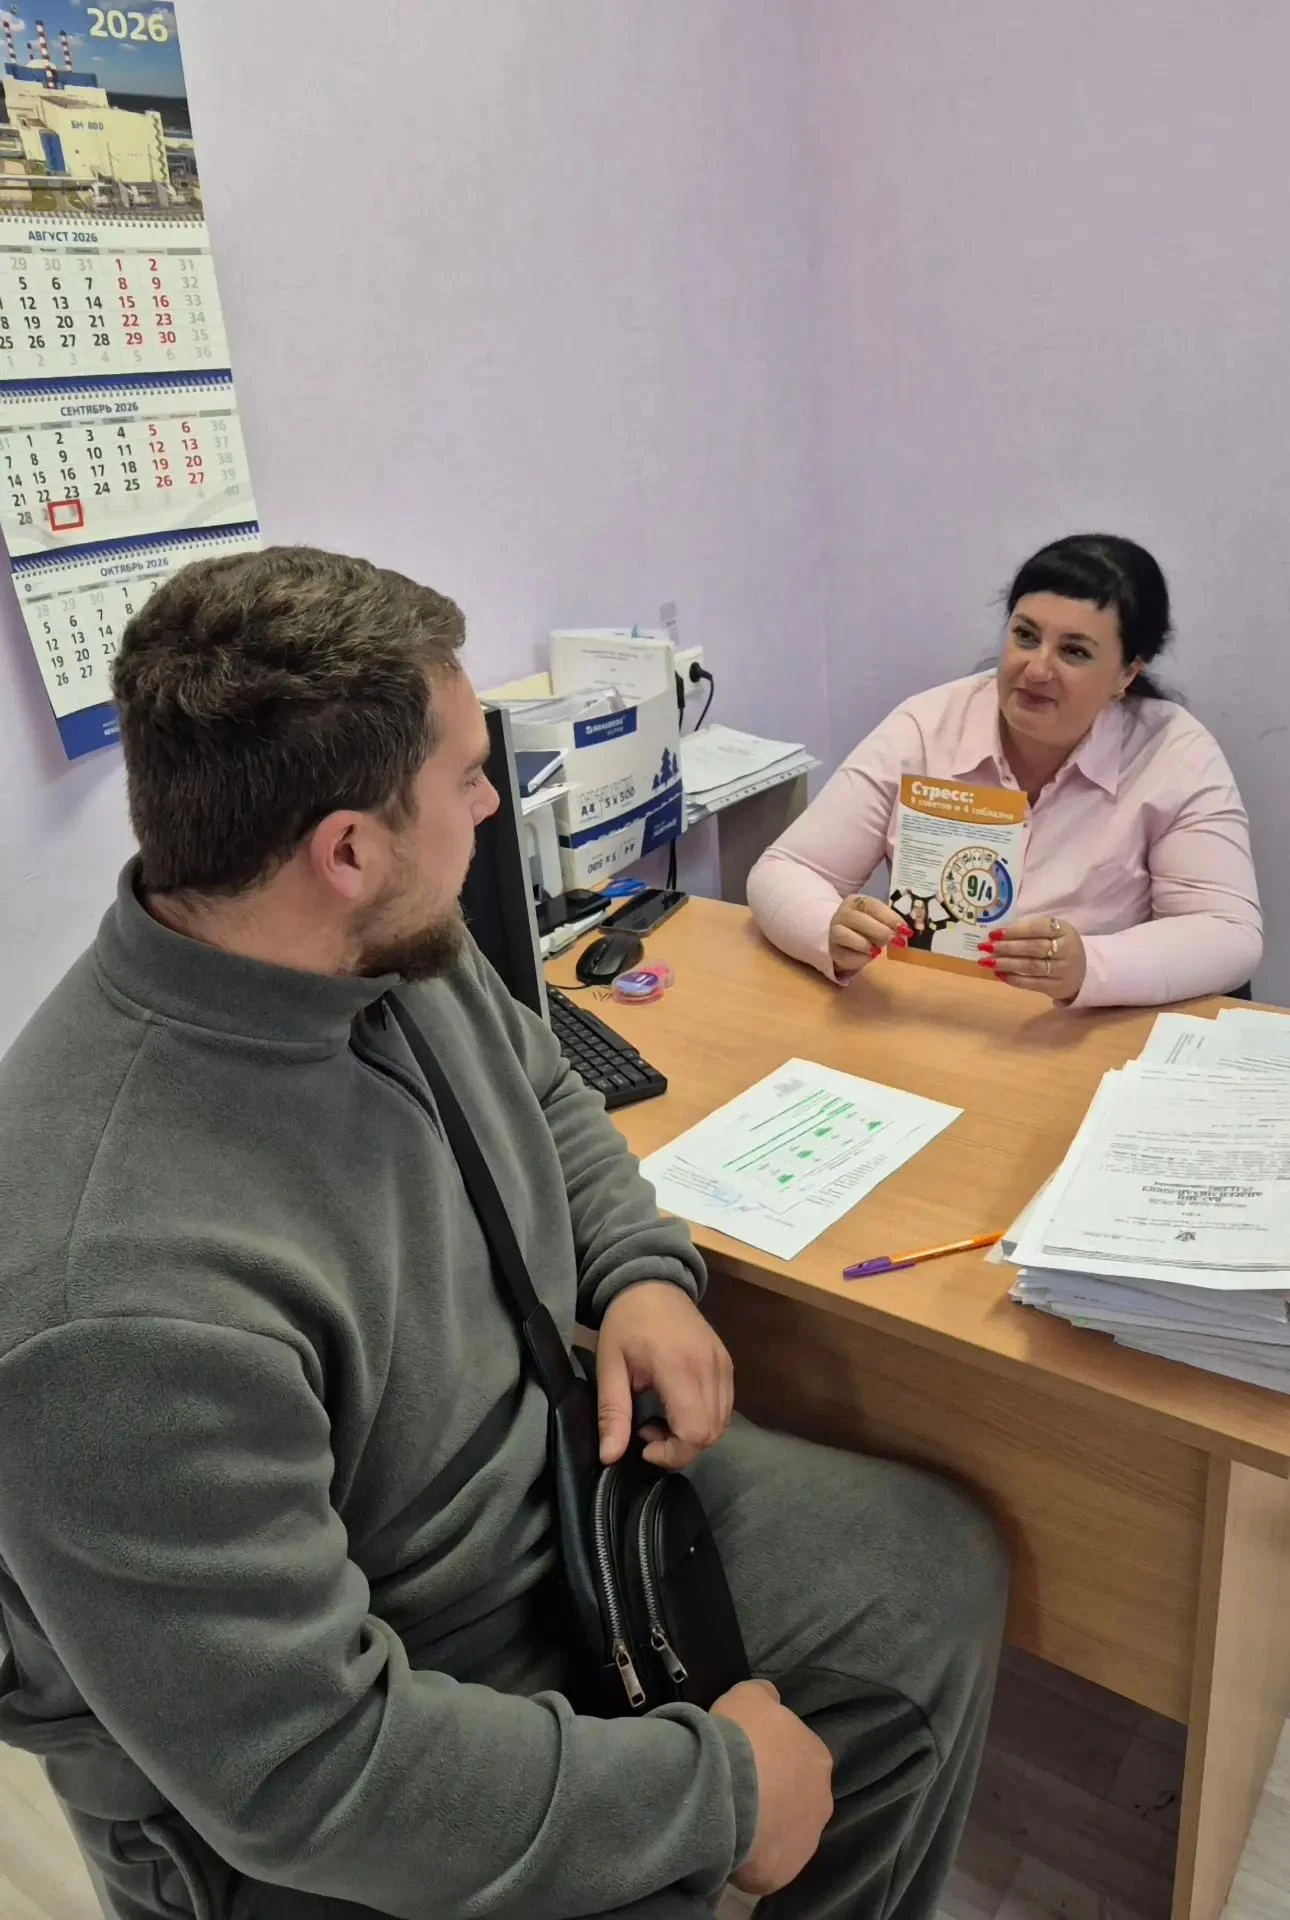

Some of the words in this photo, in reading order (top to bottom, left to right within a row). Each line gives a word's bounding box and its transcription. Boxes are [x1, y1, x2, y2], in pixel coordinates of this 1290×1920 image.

[86, 7, 169, 42] 2026
[28, 230, 69, 242] АВГУСТ
[71, 232, 98, 243] 2026
[10, 257, 27, 271] 29
[43, 258, 61, 271] 30
[76, 258, 94, 271] 31
[115, 259, 123, 271] 1
[149, 259, 158, 271] 2
[18, 277, 27, 290] 5
[51, 277, 61, 290] 6
[84, 277, 93, 290] 7
[118, 277, 128, 290] 8
[152, 277, 161, 290] 9
[19, 296, 37, 310] 12
[52, 296, 69, 310] 13
[86, 296, 103, 310] 14
[119, 296, 135, 309] 15
[152, 295, 169, 308] 16
[0, 316, 10, 330] 8
[24, 316, 41, 329] 19
[56, 316, 74, 329] 20
[88, 315, 105, 328] 21
[121, 314, 140, 327] 22
[155, 313, 173, 326] 23
[28, 335, 45, 349] 26
[60, 334, 76, 348] 27
[93, 334, 110, 346] 28
[125, 332, 143, 345] 29
[159, 331, 176, 344] 30
[60, 403, 112, 417] СЕНТЯБРЬ
[115, 402, 139, 414] 2026
[27, 435, 34, 448] 1
[55, 432, 64, 445] 2
[86, 429, 94, 442] 3
[117, 426, 126, 439] 4
[148, 424, 158, 437] 5
[182, 422, 191, 434] 6
[5, 456, 13, 469] 7
[30, 453, 39, 466] 8
[59, 450, 68, 464] 9
[86, 447, 103, 460] 10
[117, 444, 132, 457] 11
[149, 442, 165, 454] 12
[182, 439, 198, 451] 13
[8, 474, 23, 488] 14
[32, 471, 47, 485] 15
[60, 468, 76, 481] 16
[90, 464, 105, 477] 17
[121, 461, 137, 474] 18
[152, 458, 169, 471] 19
[184, 455, 203, 468] 20
[12, 494, 27, 508] 21
[36, 490, 52, 503] 22
[63, 486, 80, 499] 23
[94, 482, 111, 496] 24
[124, 479, 141, 492] 25
[155, 475, 173, 488] 26
[188, 472, 205, 485] 27
[17, 512, 33, 526] 28
[99, 561, 144, 578] ОКТЯБРЬ
[146, 557, 169, 570] 2026
[122, 587, 129, 598] 1
[43, 621, 51, 635] 5
[69, 615, 77, 628] 6
[96, 609, 104, 622] 7
[125, 603, 134, 615] 8
[45, 638, 59, 652] 12
[71, 631, 86, 645] 13
[98, 625, 113, 638] 14
[51, 656, 64, 669] 19
[75, 648, 90, 662] 20
[102, 642, 117, 655] 21
[55, 673, 69, 687] 26
[79, 665, 93, 679] 27
[580, 803, 596, 816] A4
[604, 799, 611, 809] 5
[612, 797, 618, 806] x
[619, 786, 636, 802] 500
[911, 781, 975, 804] Стресс:
[966, 875, 994, 901] 9/4
